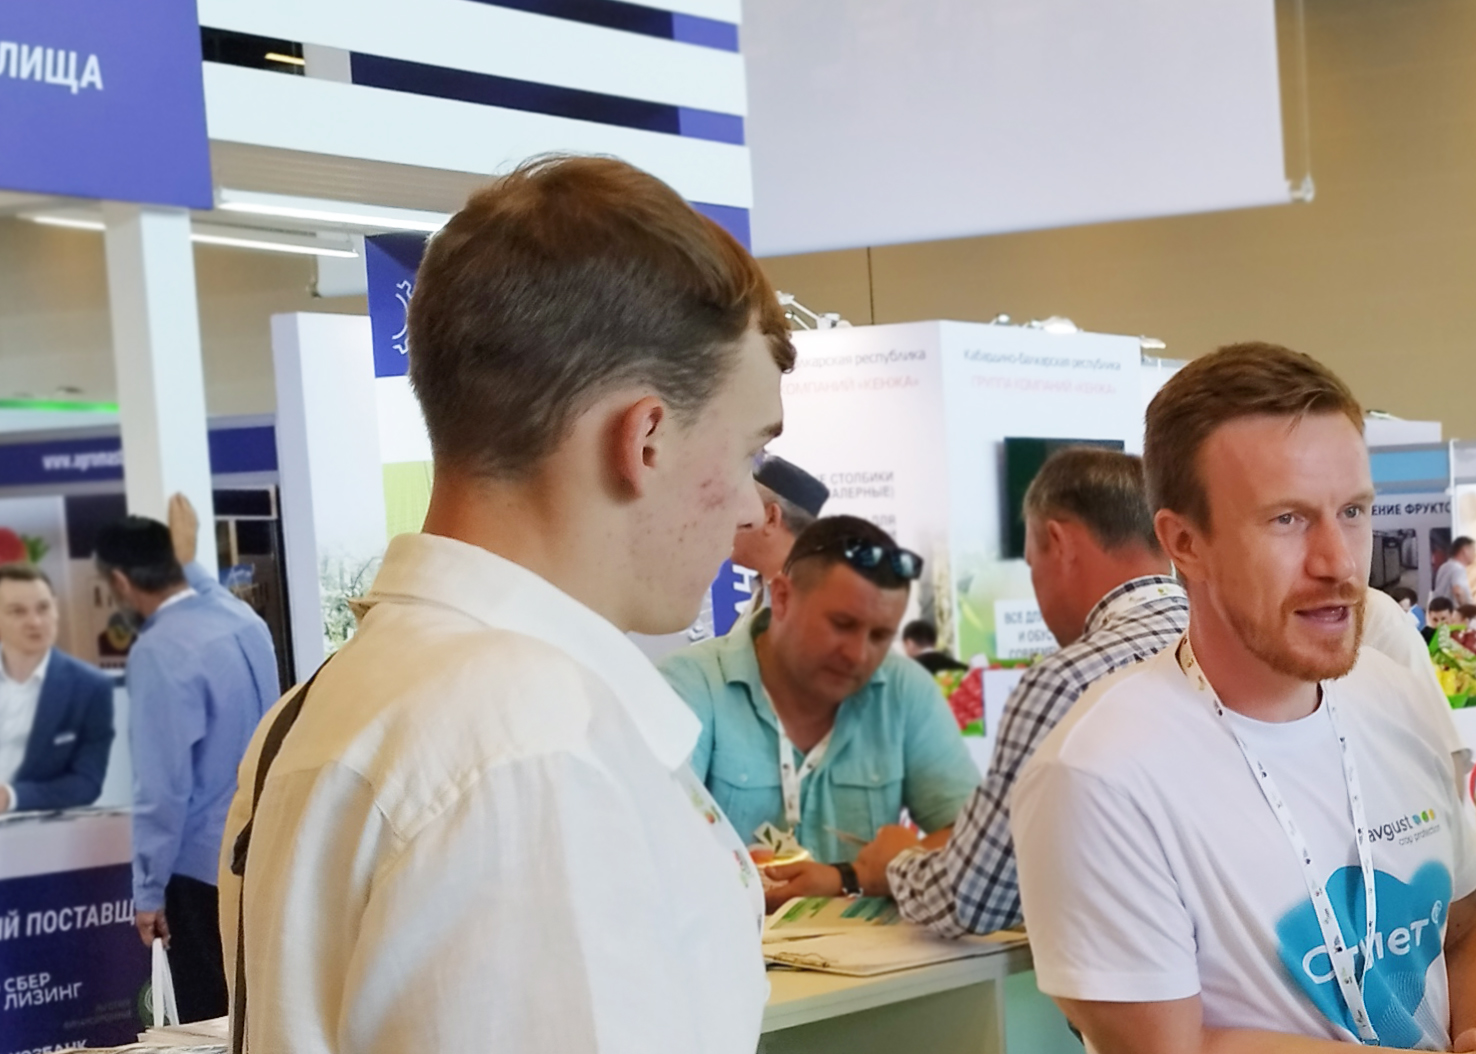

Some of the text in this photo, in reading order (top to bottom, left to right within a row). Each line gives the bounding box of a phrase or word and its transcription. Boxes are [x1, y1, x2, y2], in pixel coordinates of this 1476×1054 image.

[0, 41, 103, 95] ЛИЩА
[855, 349, 926, 367] республика
[830, 471, 894, 485] СТОЛБИКИ
[1368, 815, 1413, 843] avgust
[4, 972, 51, 993] СБЕР
[4, 982, 83, 1011] ЛИЗИНГ
